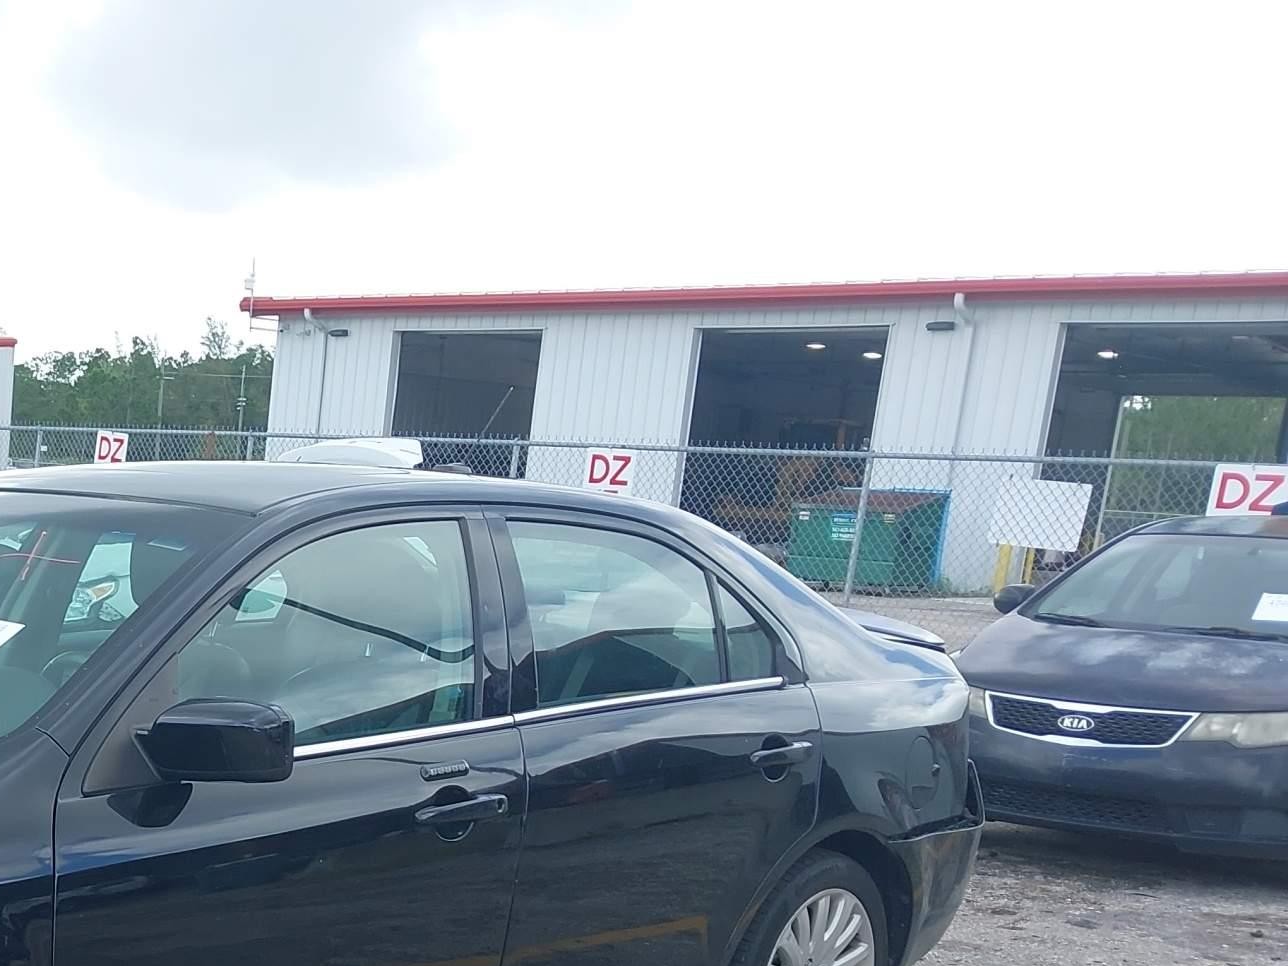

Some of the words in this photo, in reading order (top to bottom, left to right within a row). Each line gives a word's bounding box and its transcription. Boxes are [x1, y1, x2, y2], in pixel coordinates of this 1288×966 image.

[98, 436, 125, 463] DZ
[589, 454, 632, 486] DZ
[1215, 472, 1285, 512] DZ
[1063, 717, 1088, 729] KIA
